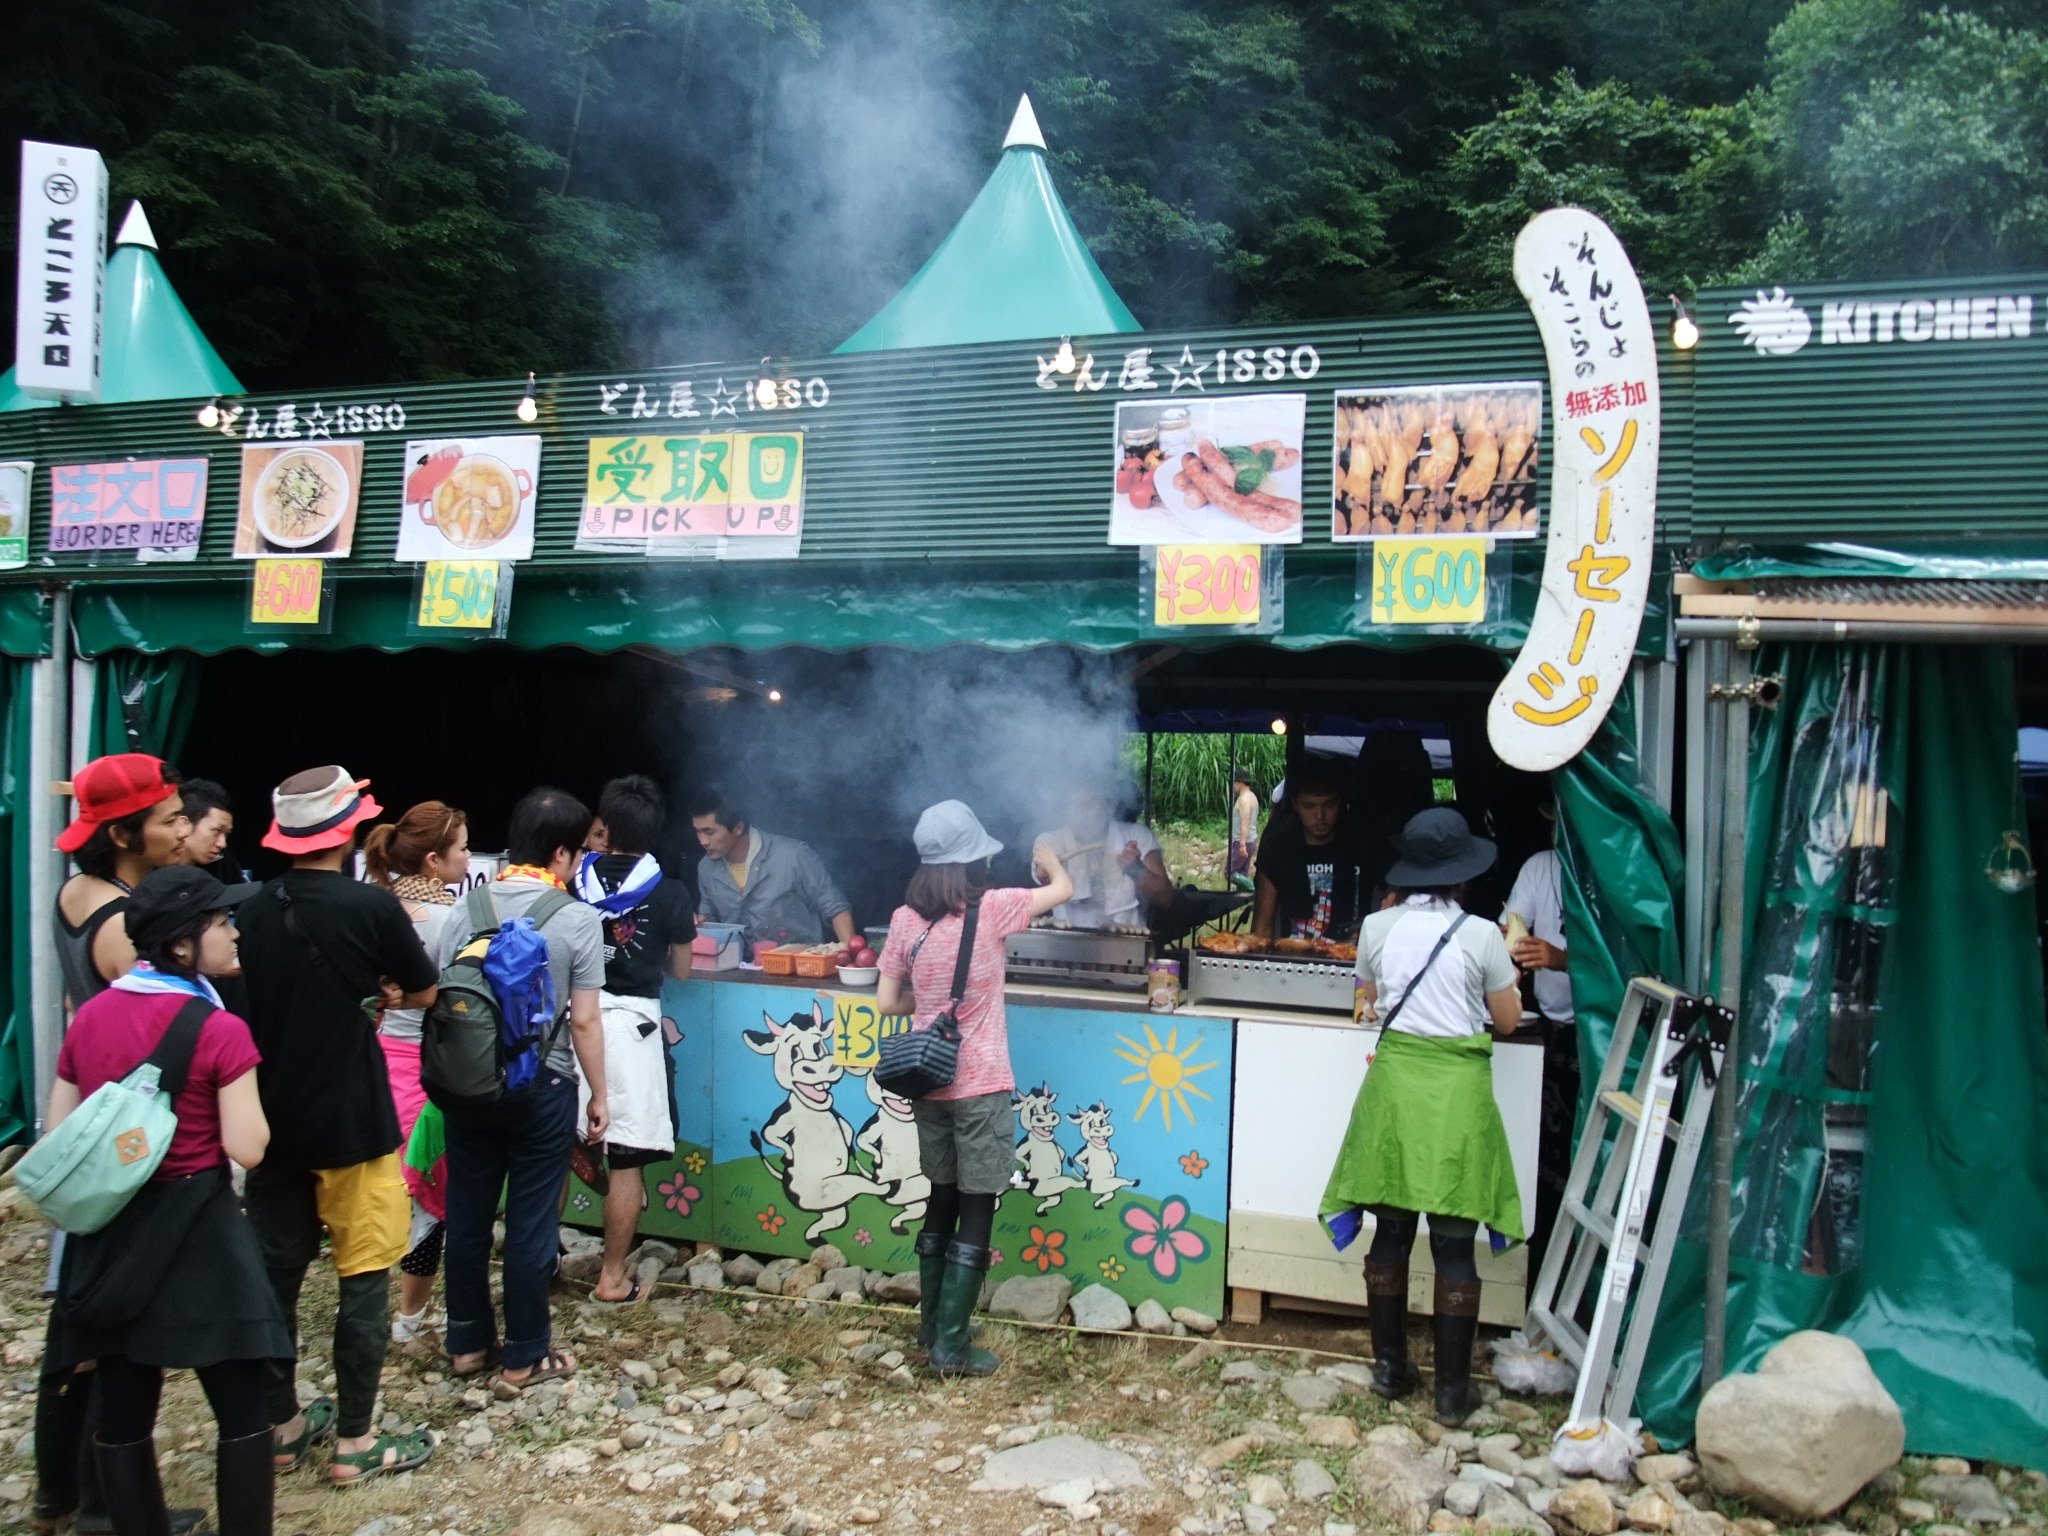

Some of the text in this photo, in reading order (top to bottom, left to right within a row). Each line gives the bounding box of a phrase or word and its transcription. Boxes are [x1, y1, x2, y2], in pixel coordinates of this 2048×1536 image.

[1543, 265, 1597, 379] そこらの
[1820, 295, 2033, 345] KITCHEN
[1565, 380, 1648, 418] 無添加
[54, 461, 207, 523] 注文口
[596, 436, 799, 504] 受取口
[67, 523, 141, 547] ORDER
[611, 505, 776, 534] PICK UP
[256, 563, 319, 618] ¥600
[421, 564, 493, 624] ¥500
[1158, 549, 1261, 621] ¥300
[1375, 547, 1482, 621] ¥600
[1512, 418, 1639, 727] ソーセージ
